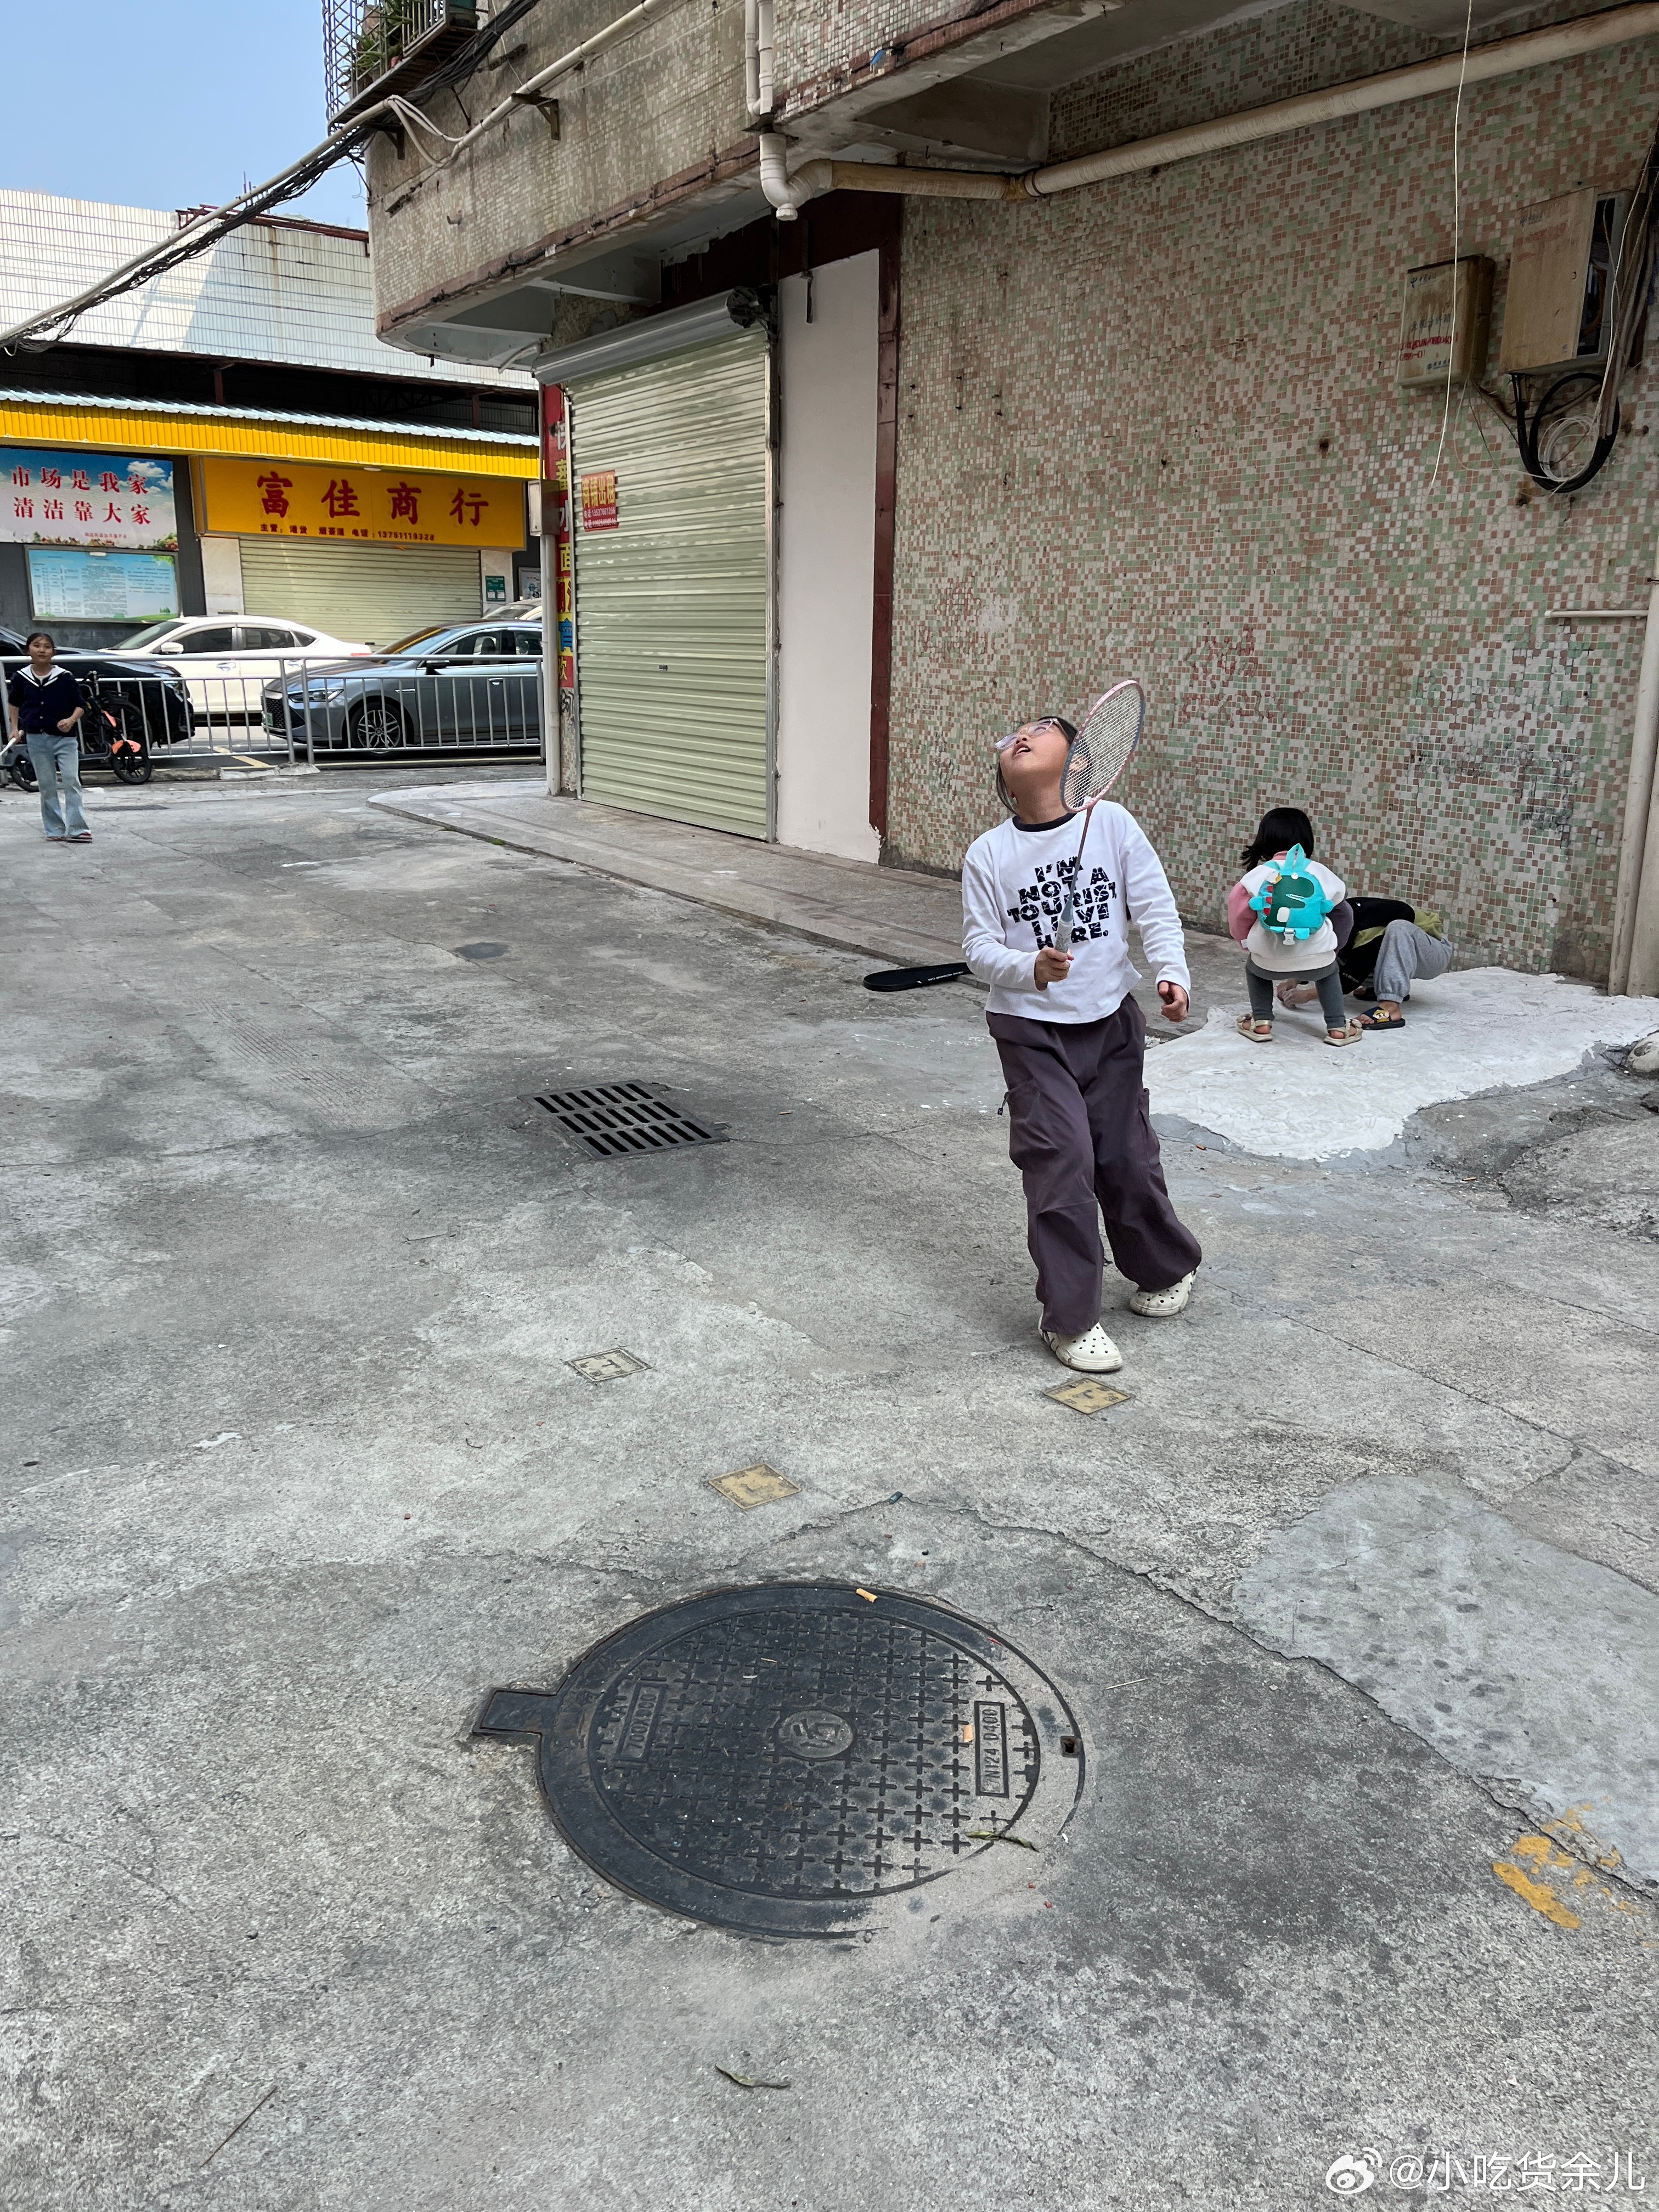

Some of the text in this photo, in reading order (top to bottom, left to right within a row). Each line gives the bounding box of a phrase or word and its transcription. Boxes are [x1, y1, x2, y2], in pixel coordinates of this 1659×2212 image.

[12, 465, 148, 494] 市场是我家
[583, 475, 614, 508] 商铺出租
[14, 496, 151, 524] 清洁靠大家
[256, 471, 489, 526] 富佳商行
[1035, 856, 1084, 883] I'M
[1018, 867, 1109, 904] NOT A
[1031, 921, 1042, 936] I
[1036, 922, 1109, 950] HRE.
